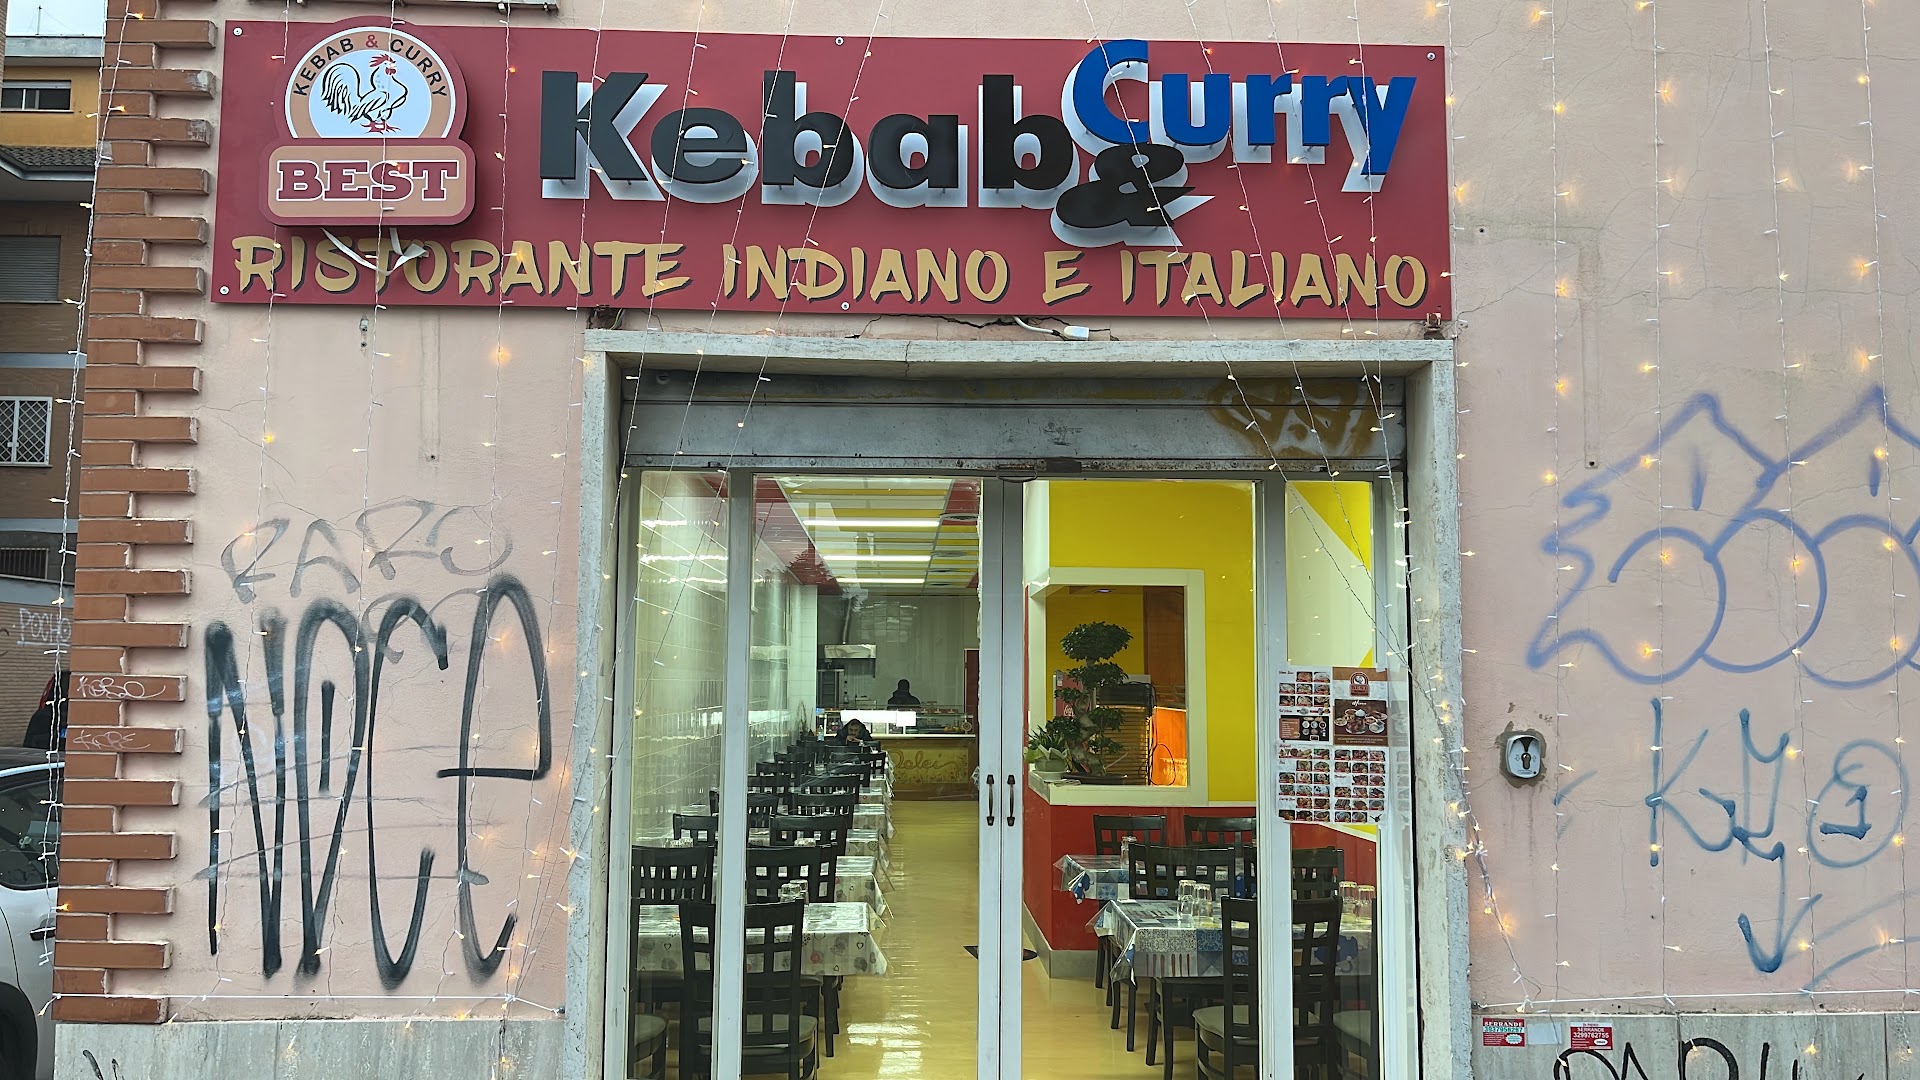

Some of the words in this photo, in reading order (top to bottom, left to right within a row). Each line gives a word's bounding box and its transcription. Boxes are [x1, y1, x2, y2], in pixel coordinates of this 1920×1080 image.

[293, 38, 354, 97] KEBAB
[365, 34, 379, 48] &
[390, 38, 448, 97] CURRY
[541, 70, 1073, 198] Kebab
[1066, 38, 1417, 184] Curry
[276, 160, 460, 202] BEST
[1054, 143, 1203, 238] &
[231, 235, 691, 296] RISTORANTE
[722, 243, 1009, 303] INDIANO
[1042, 250, 1091, 304] E
[1120, 249, 1427, 307] ITALIANO
